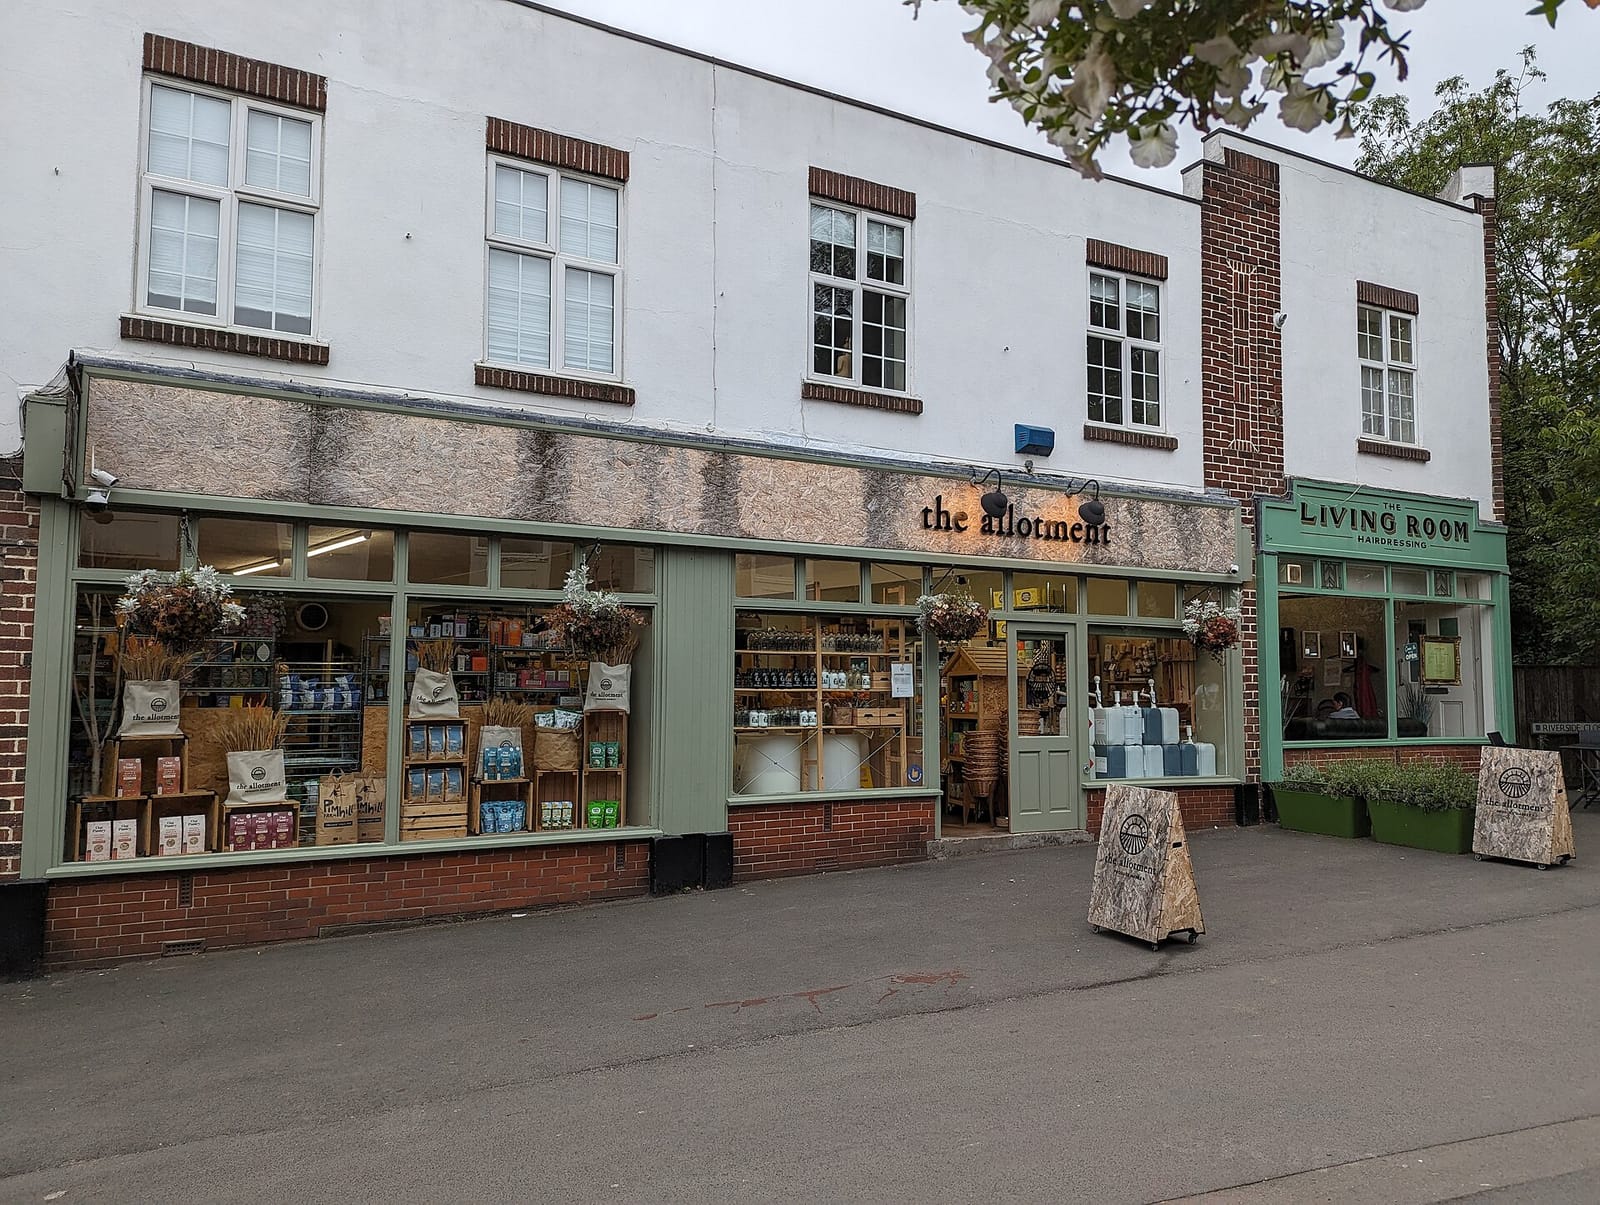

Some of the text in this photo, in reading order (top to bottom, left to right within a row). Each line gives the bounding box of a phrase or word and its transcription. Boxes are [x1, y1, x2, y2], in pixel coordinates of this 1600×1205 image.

[1383, 502, 1401, 511] THE
[920, 494, 1111, 545] the allotment
[1300, 502, 1470, 543] LIVING ROOM
[1357, 535, 1427, 549] HAIRDRESSING
[133, 713, 145, 721] the
[1542, 724, 1581, 732] RIVERSIDE
[250, 781, 281, 789] allotment
[1486, 797, 1544, 812] the allotment
[1105, 852, 1117, 865] the
[1120, 856, 1156, 875] allotment
